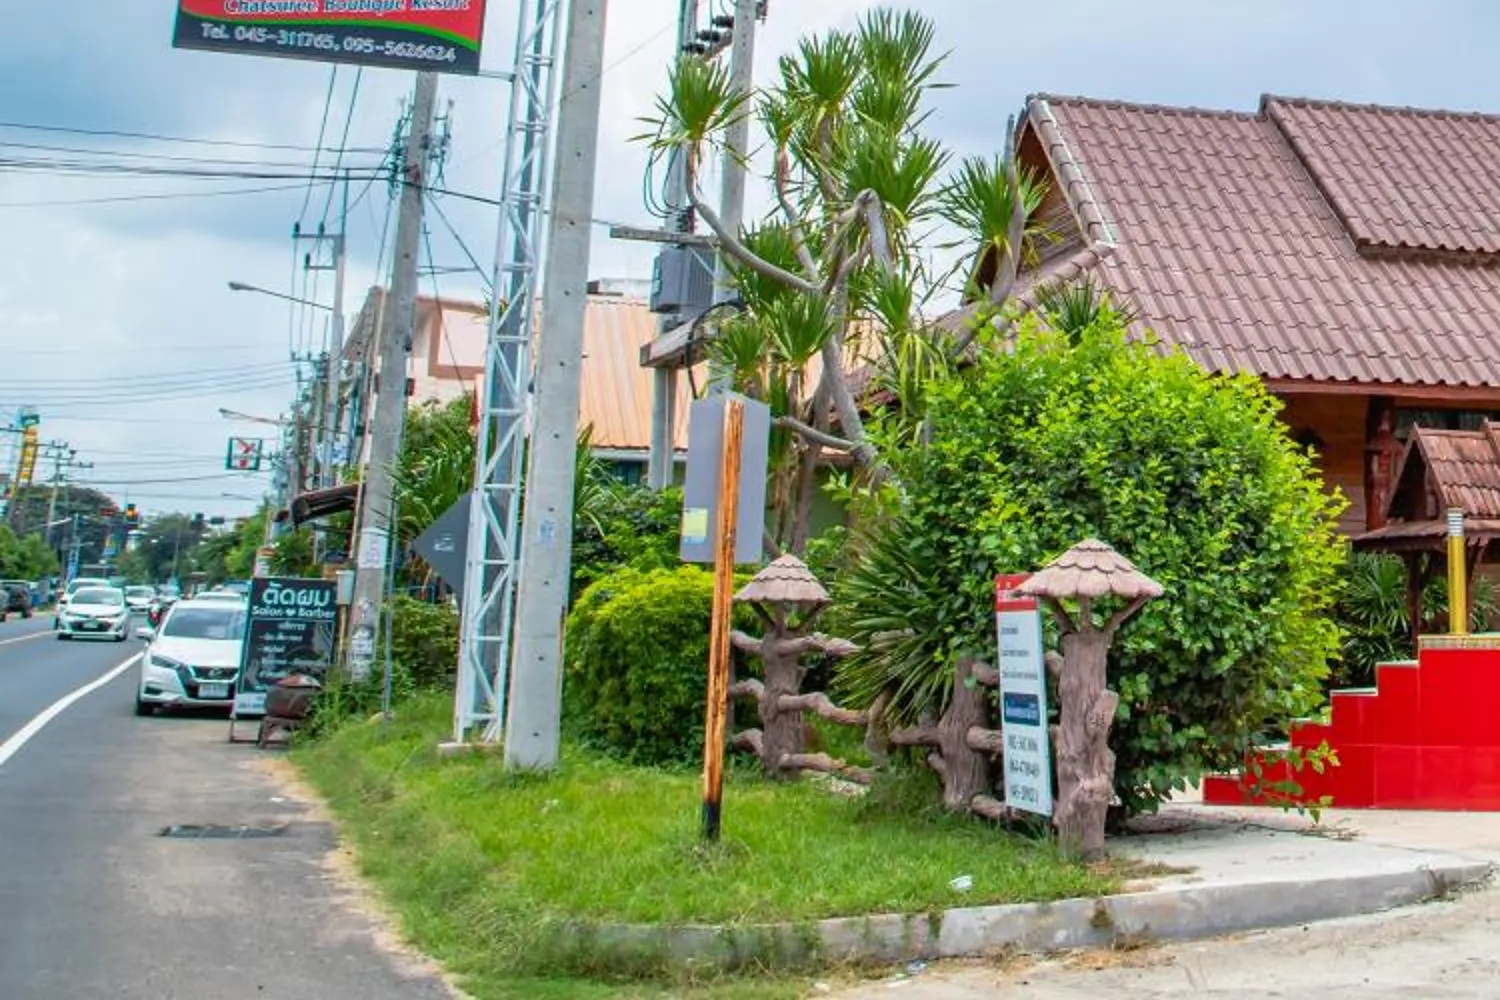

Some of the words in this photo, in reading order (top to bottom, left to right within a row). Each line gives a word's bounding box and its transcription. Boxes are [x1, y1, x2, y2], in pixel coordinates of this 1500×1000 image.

[262, 581, 331, 607] ตัดผม
[252, 606, 283, 616] Salon
[297, 607, 336, 617] Barber
